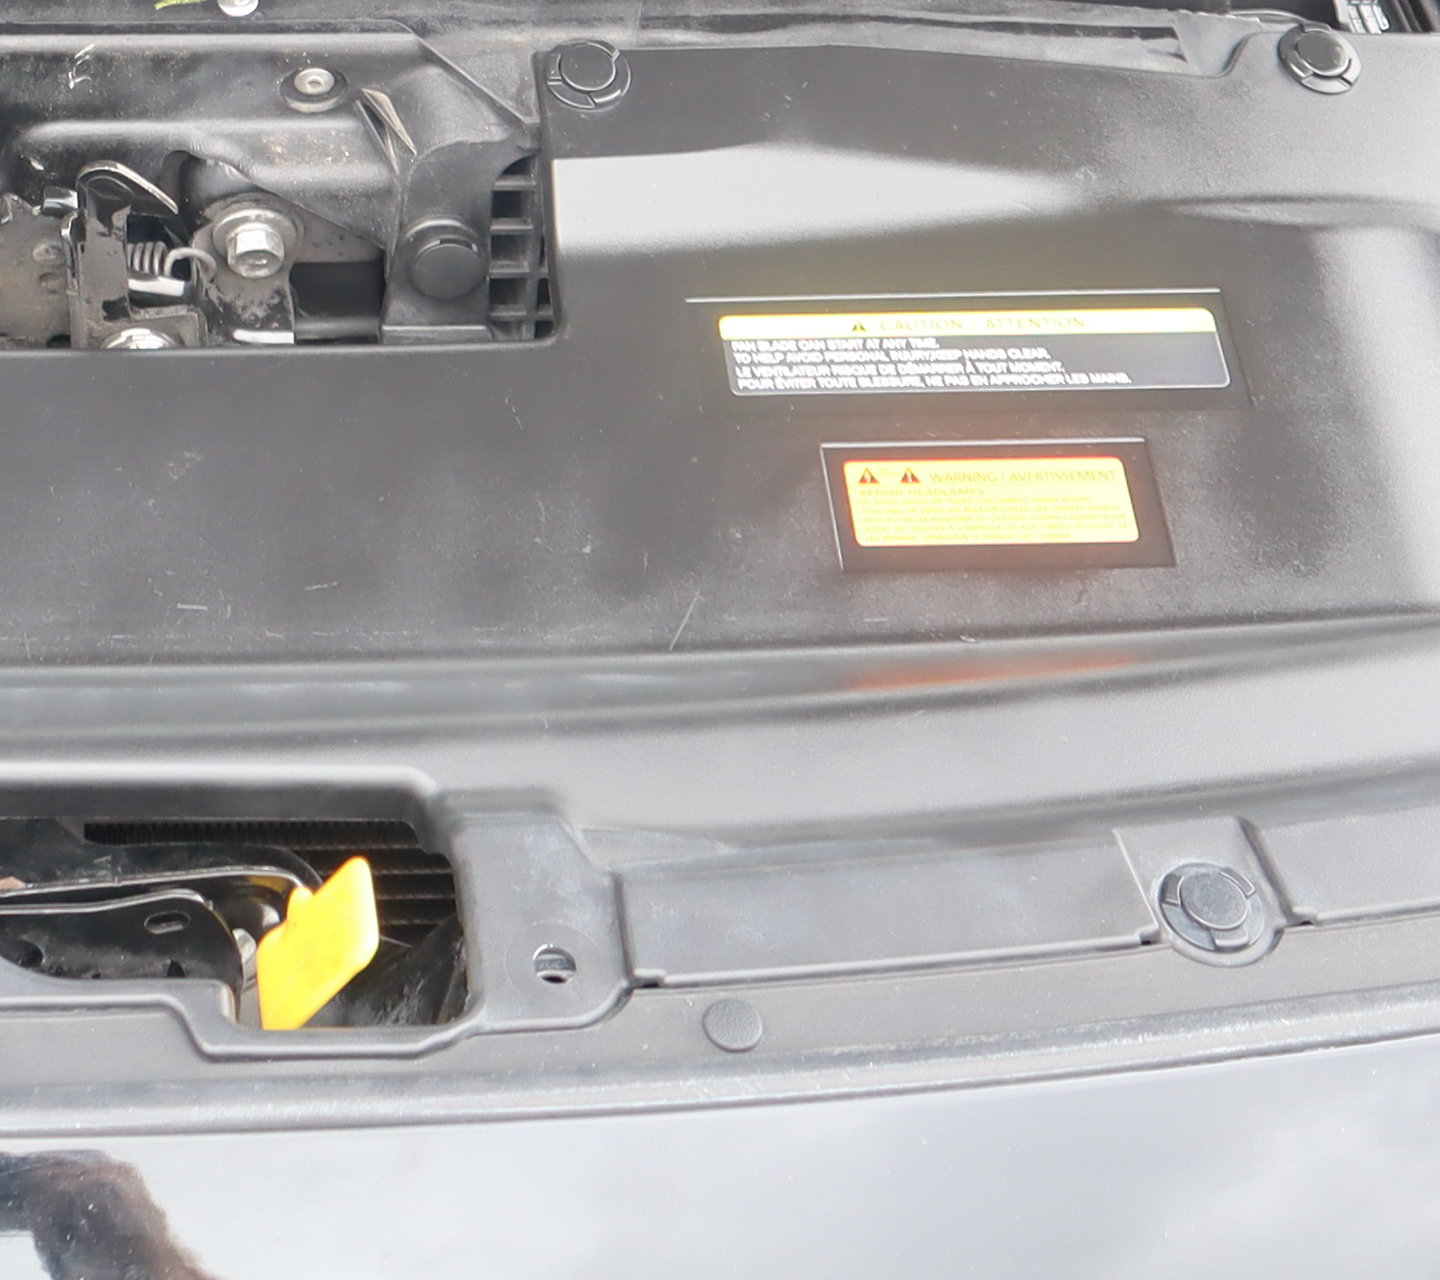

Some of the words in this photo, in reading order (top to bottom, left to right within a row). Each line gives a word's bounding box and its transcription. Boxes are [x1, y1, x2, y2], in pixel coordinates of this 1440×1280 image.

[880, 319, 962, 331] CAUTION
[985, 317, 1086, 329] ATTENTION
[798, 339, 825, 351] CAN
[865, 338, 881, 350] AT
[882, 338, 907, 350] ANY
[733, 353, 751, 364] TO
[752, 352, 784, 363] HELP
[735, 366, 752, 378] LE
[878, 364, 897, 375] DE
[975, 362, 1007, 374] TOUT
[738, 378, 774, 390] POUR
[924, 376, 944, 387] NE
[969, 375, 988, 386] EN
[929, 472, 998, 483] WARNING
[1009, 470, 1117, 482] AVERTISSEMENT
